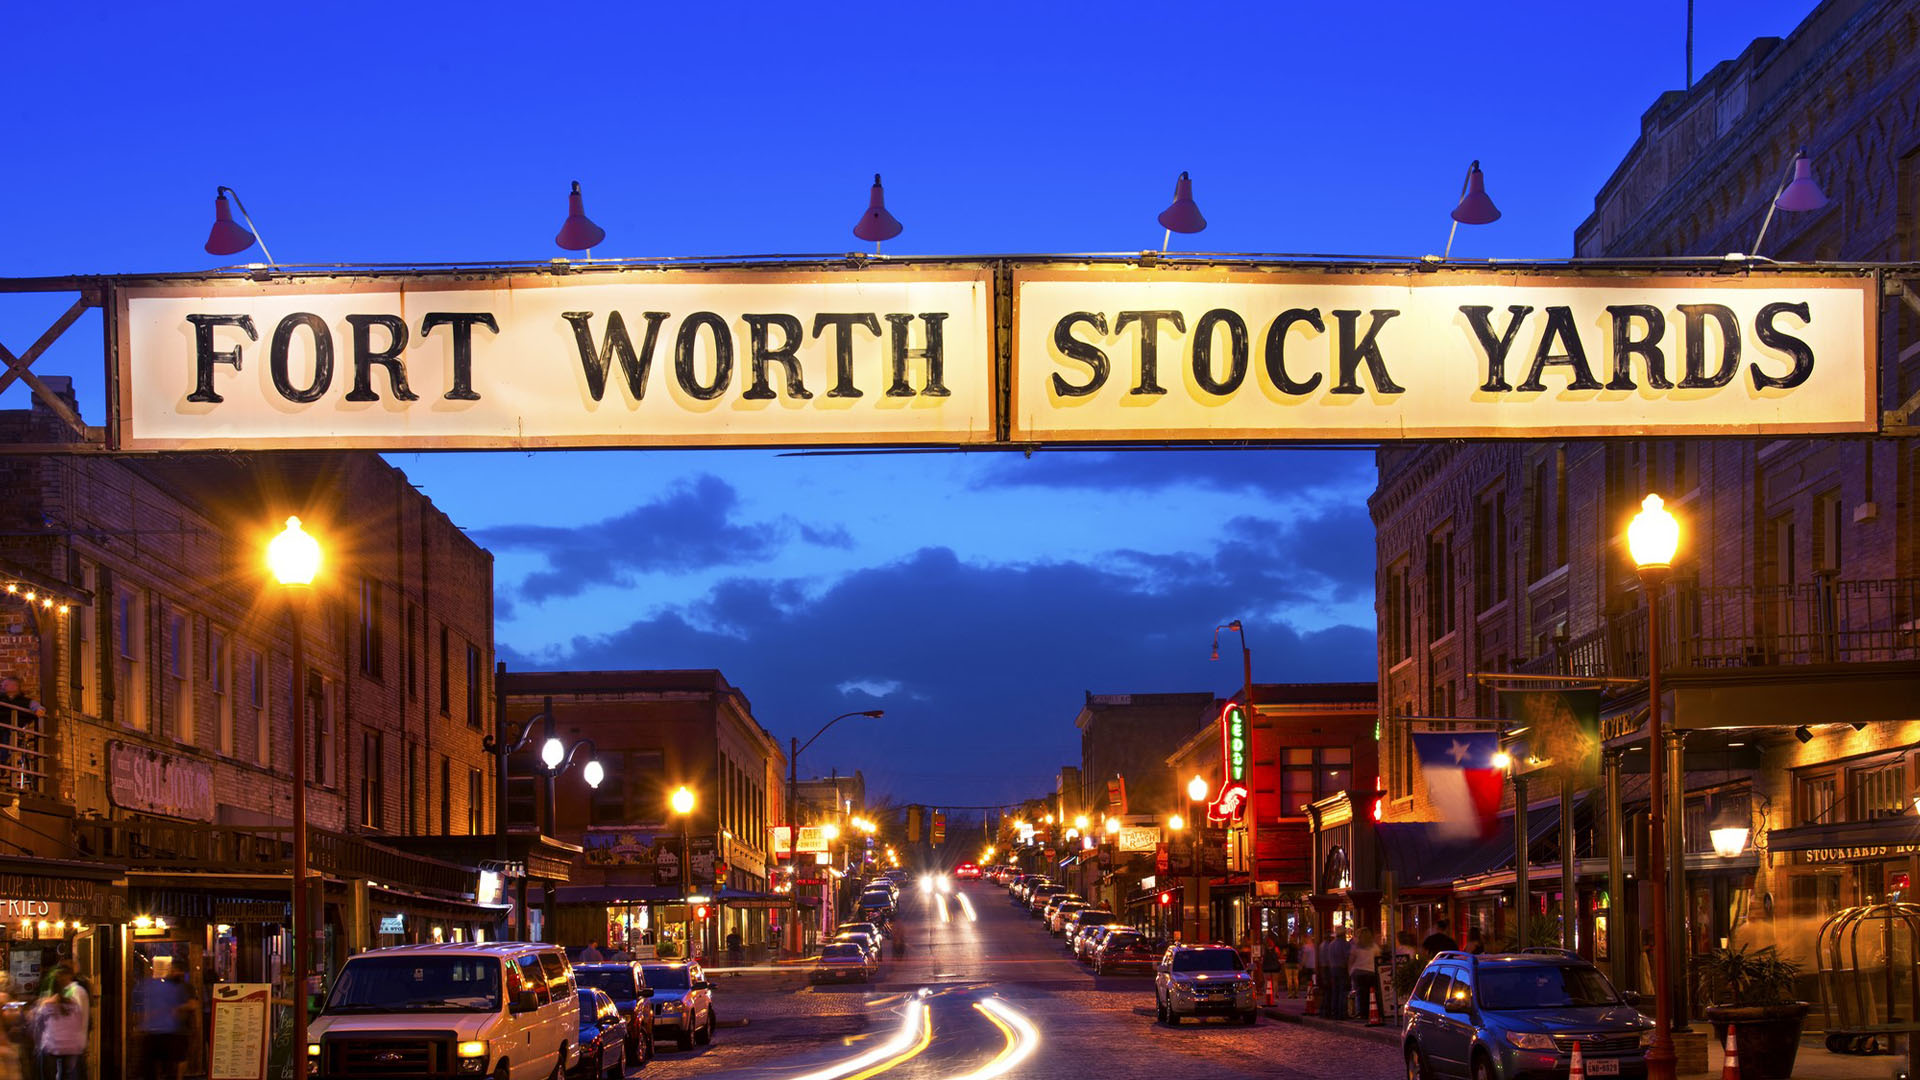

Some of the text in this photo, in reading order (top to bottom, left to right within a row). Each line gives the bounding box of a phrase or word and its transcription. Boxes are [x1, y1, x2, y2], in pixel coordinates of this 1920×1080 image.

[187, 301, 1815, 403] FORT WORTH STOCK YARDS
[1231, 710, 1244, 780] LEDDY
